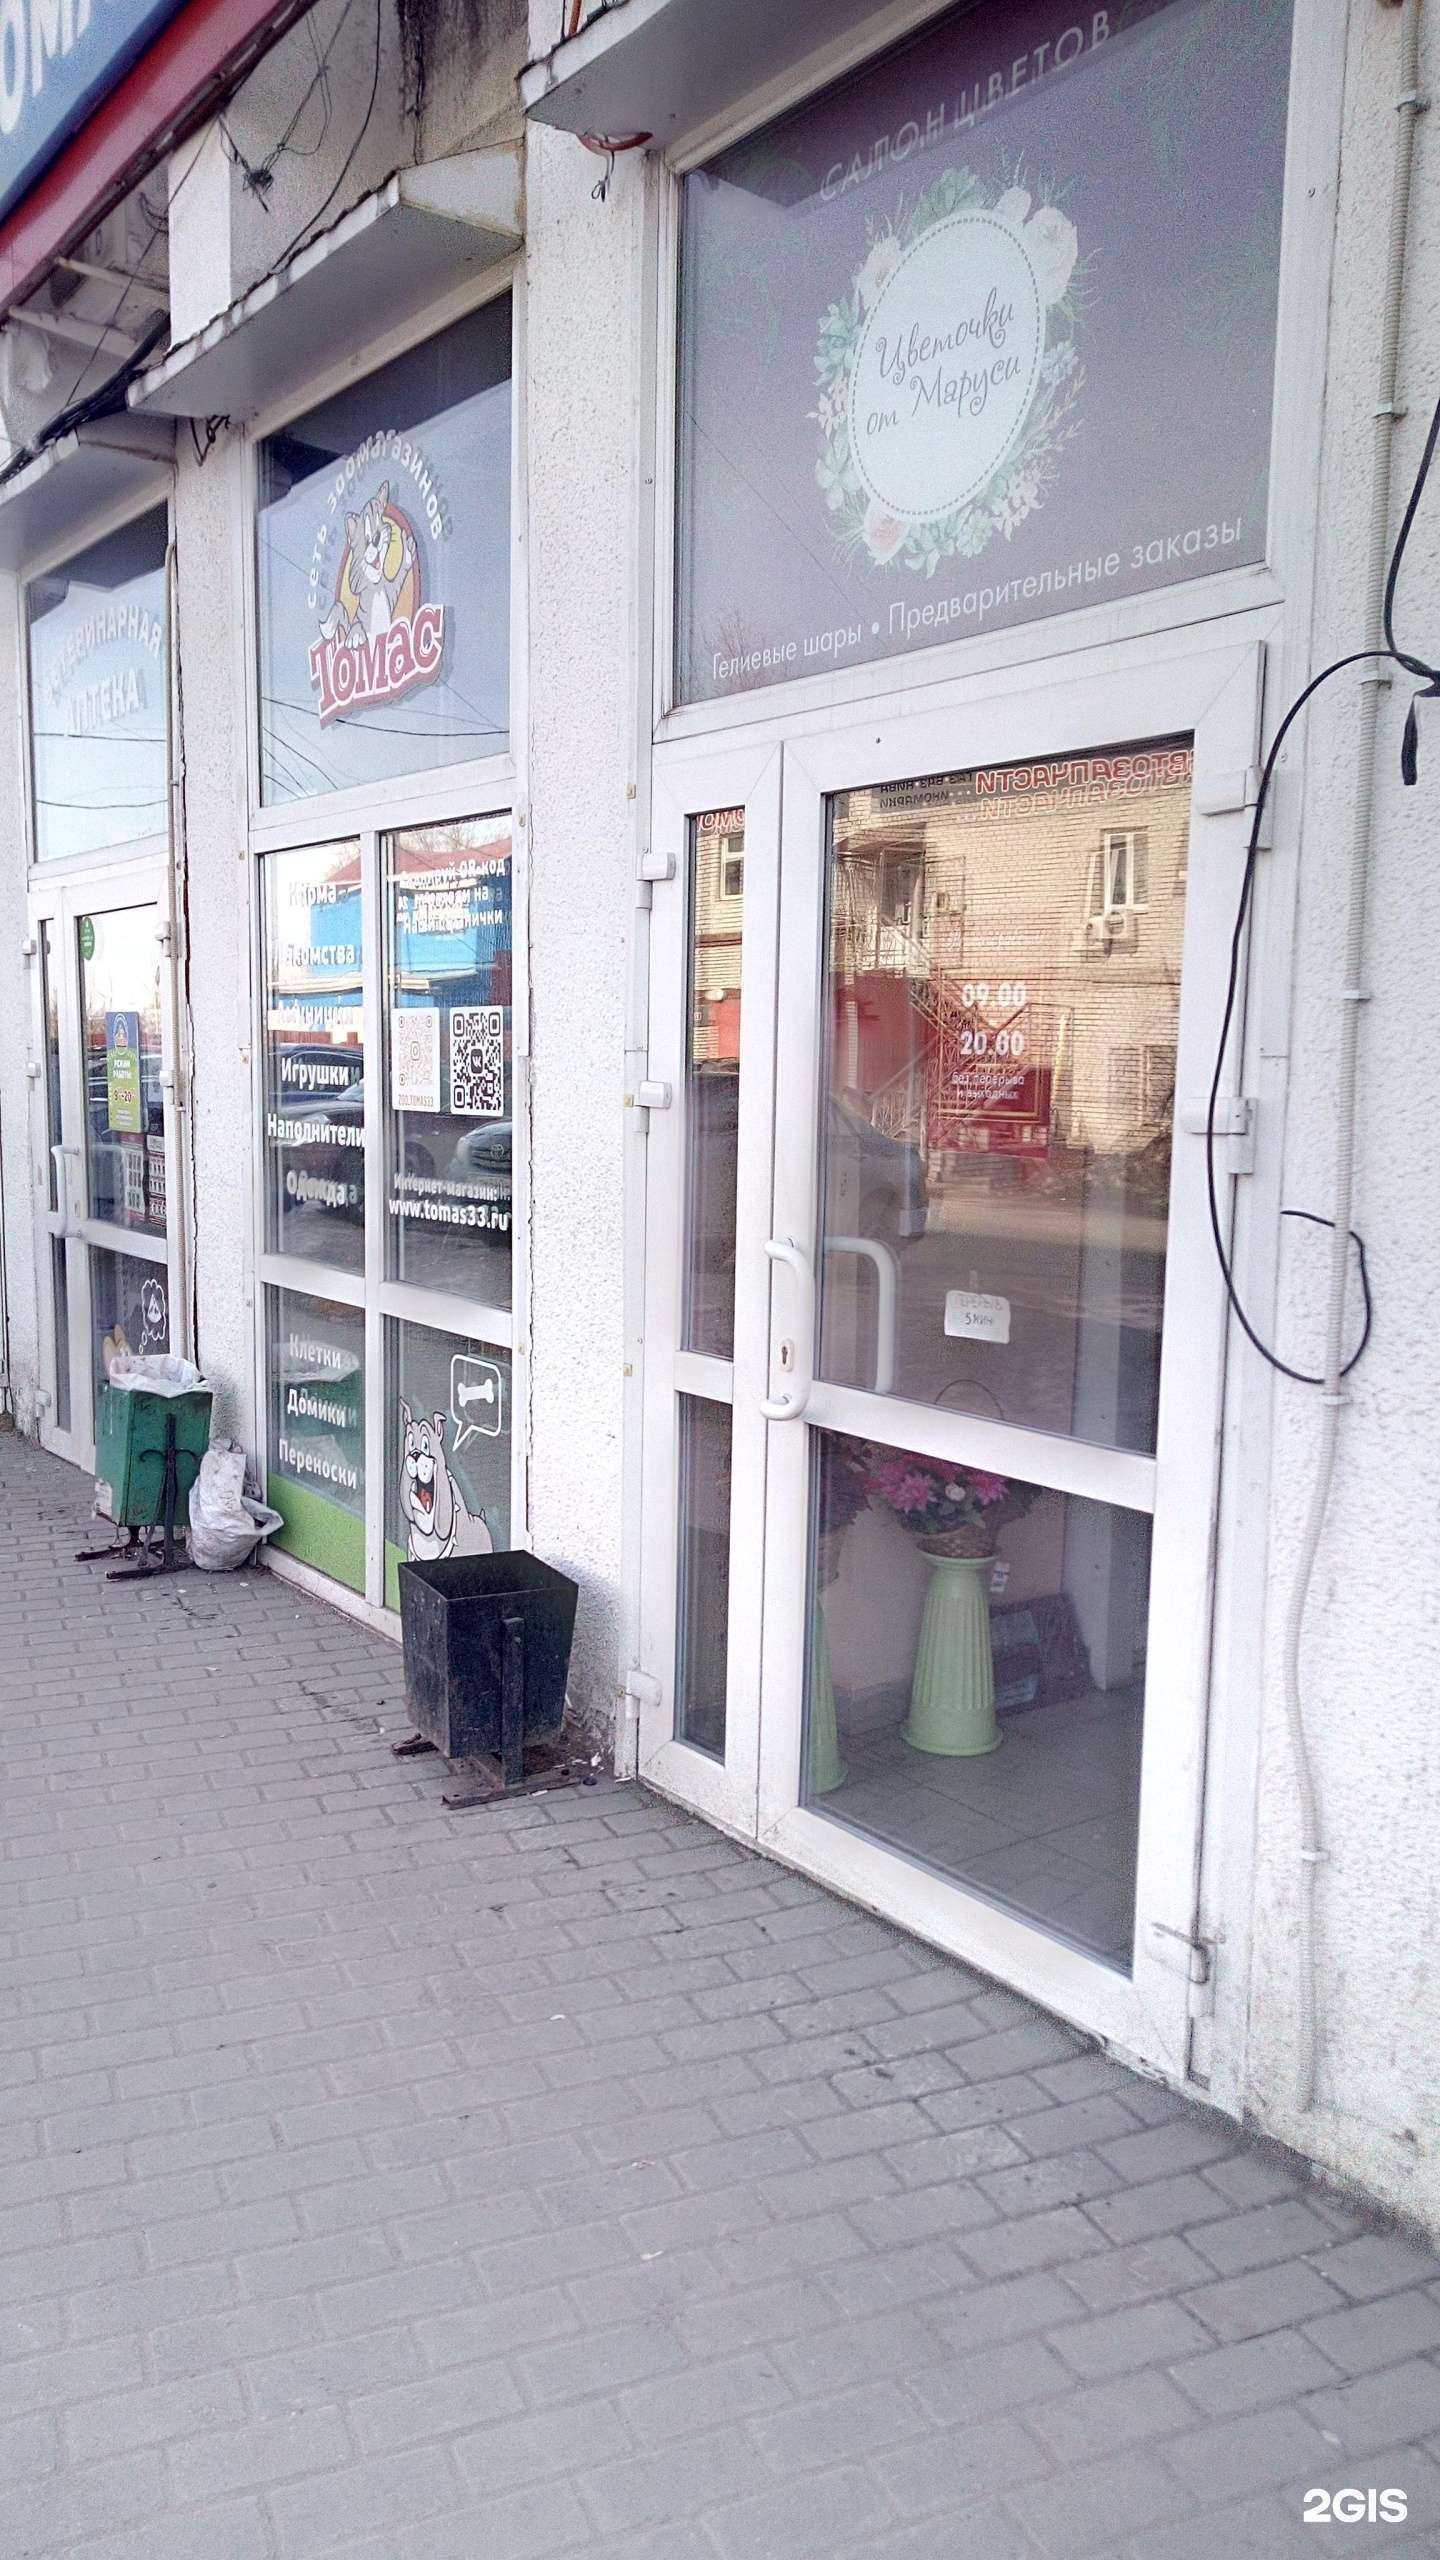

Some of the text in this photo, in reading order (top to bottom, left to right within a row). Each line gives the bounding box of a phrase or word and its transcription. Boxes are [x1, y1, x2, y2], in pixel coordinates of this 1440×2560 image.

[819, 10, 1112, 202] САЛОН ЦВЕТОВ
[874, 287, 1015, 386] Цветочки
[866, 353, 1022, 437] от Маруси
[713, 516, 1243, 681] Гелиевые шары Предварительные заказы
[281, 1057, 350, 1091] Игрушки
[267, 1113, 366, 1149] Наполнители
[388, 1198, 511, 1231] www.tomas33.ru
[288, 1332, 342, 1370] Клетки
[287, 1388, 347, 1429] Домики
[278, 1438, 358, 1490] Переноски
